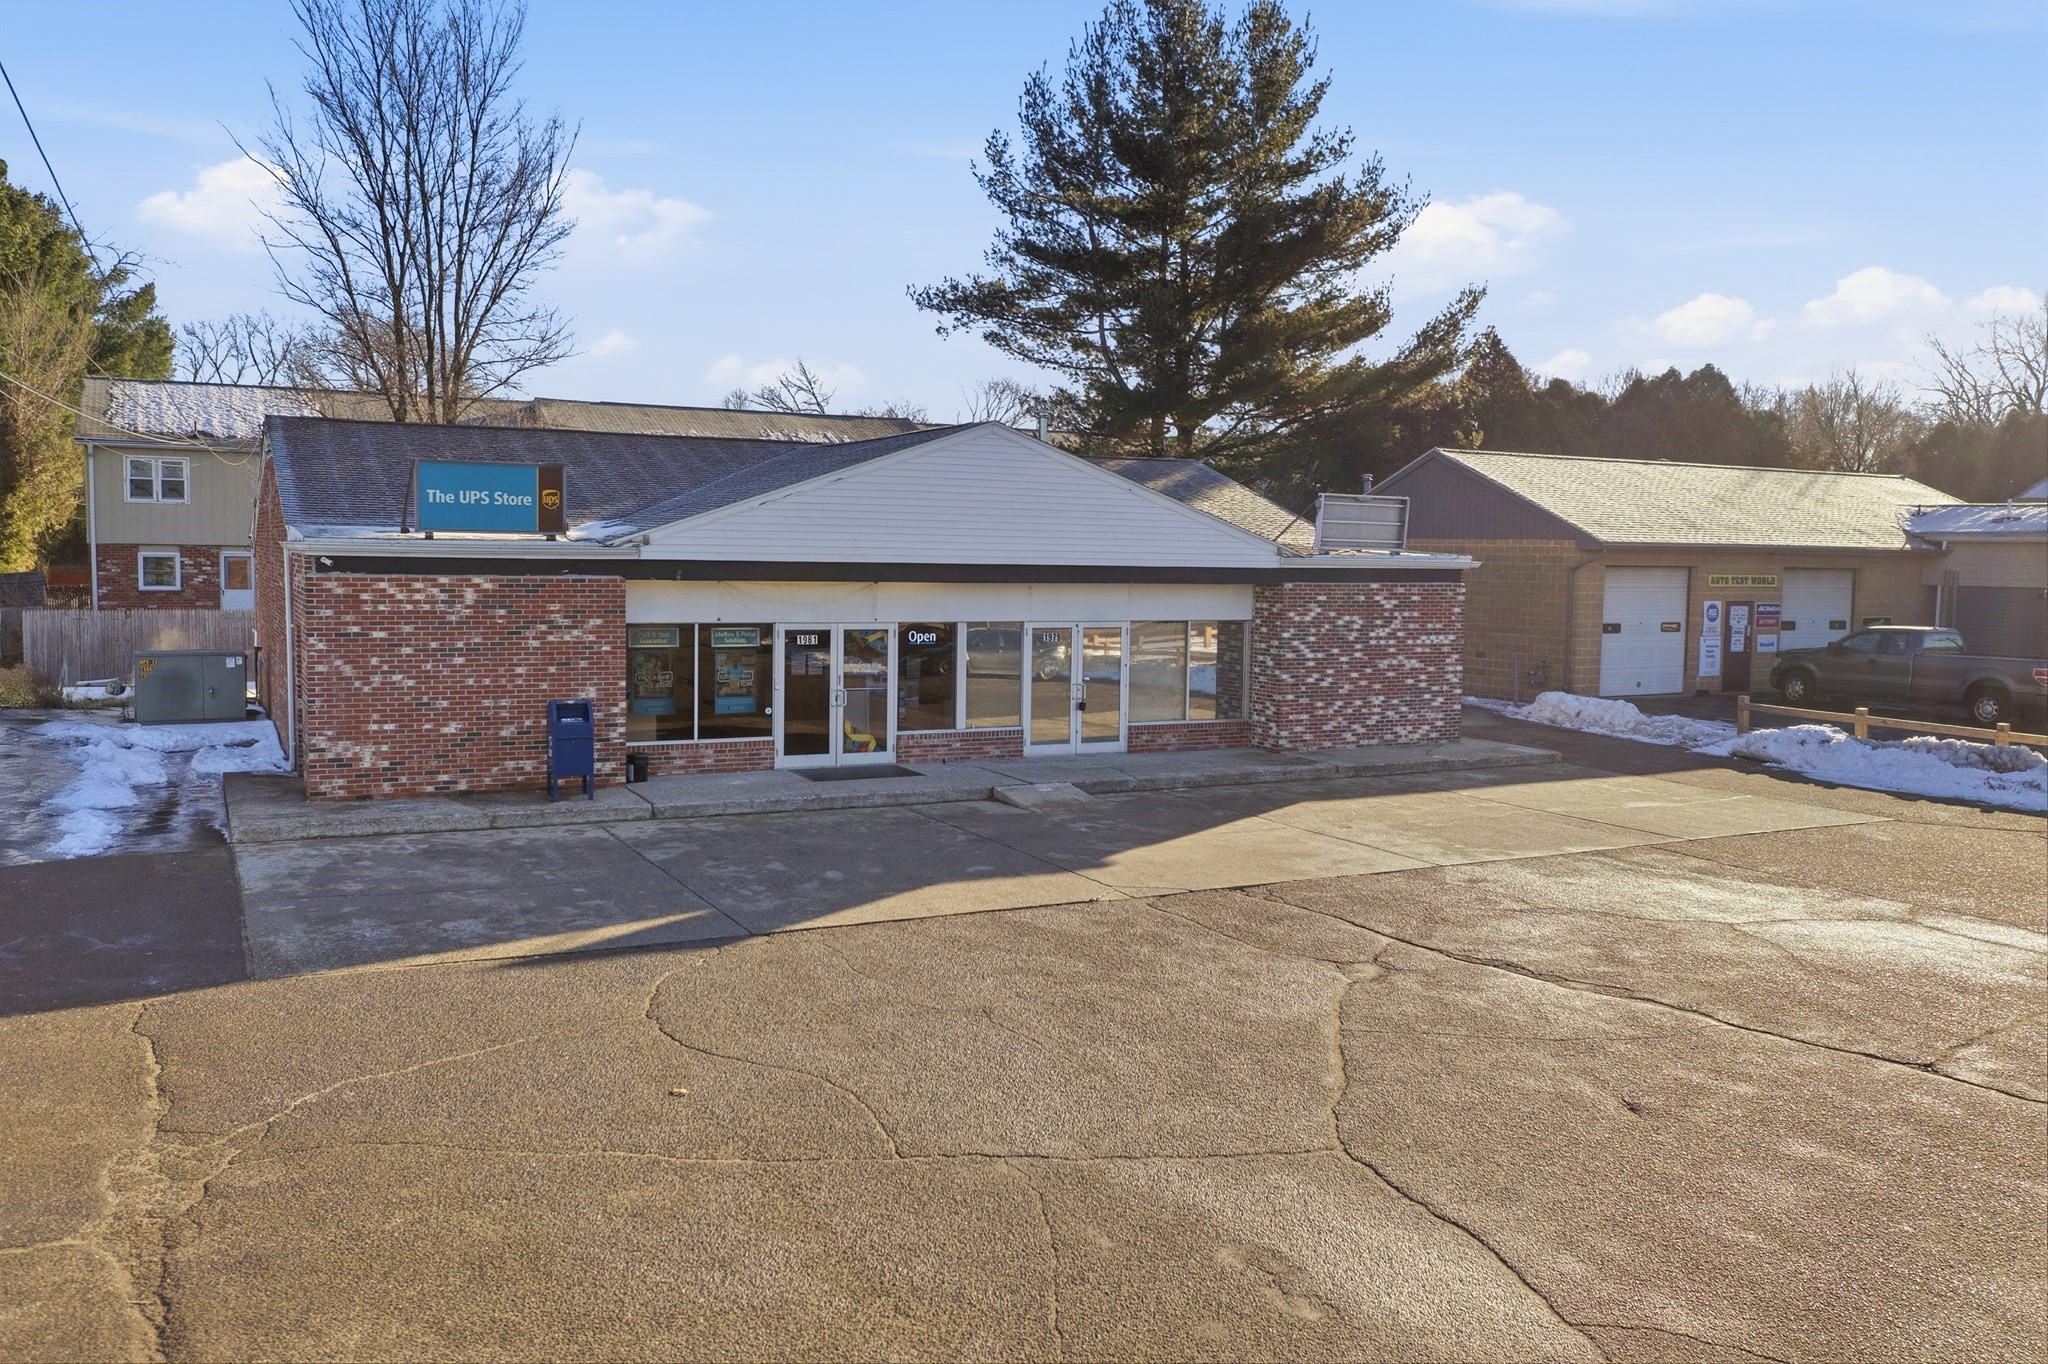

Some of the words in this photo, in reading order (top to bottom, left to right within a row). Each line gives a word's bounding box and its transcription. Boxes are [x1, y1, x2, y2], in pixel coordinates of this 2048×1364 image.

[426, 489, 455, 504] The
[459, 490, 490, 505] UPS
[494, 491, 532, 506] Store
[1710, 576, 1729, 585] AUTO
[1731, 576, 1749, 585] TEST
[1751, 576, 1776, 585] WORLD
[797, 635, 818, 644] 1981
[908, 630, 937, 645] Open
